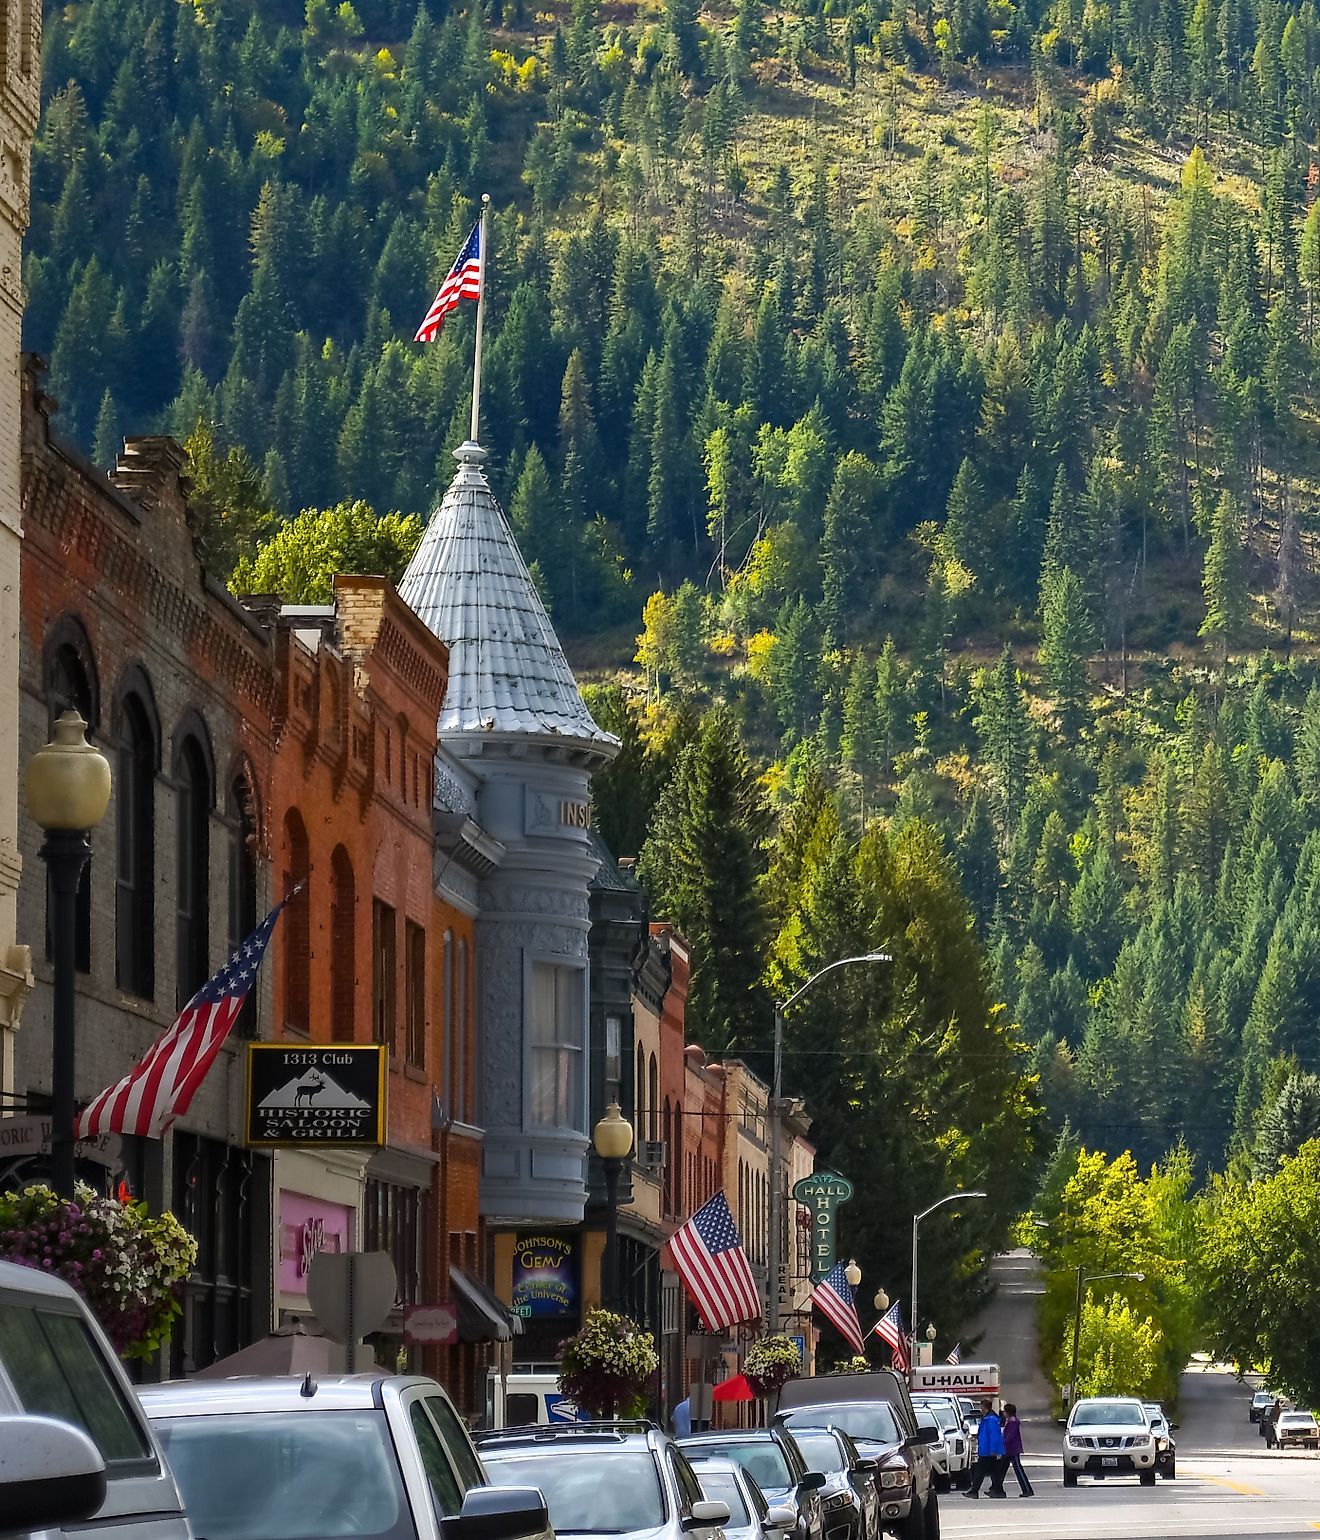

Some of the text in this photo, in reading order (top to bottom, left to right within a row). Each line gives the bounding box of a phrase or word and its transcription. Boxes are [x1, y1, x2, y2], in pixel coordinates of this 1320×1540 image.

[283, 1053, 353, 1065] 1313 Club
[259, 1109, 371, 1118] HISTORIC
[266, 1119, 361, 1128] SALOON
[263, 1129, 365, 1138] & GRILL
[804, 1186, 845, 1195] HALL
[816, 1197, 830, 1272] HOTEL
[513, 1237, 571, 1256] JOHNSON'S
[555, 1282, 567, 1293] of
[778, 1266, 787, 1304] REAL
[513, 1290, 569, 1307] the Universe
[922, 1375, 984, 1386] U-HAUL
